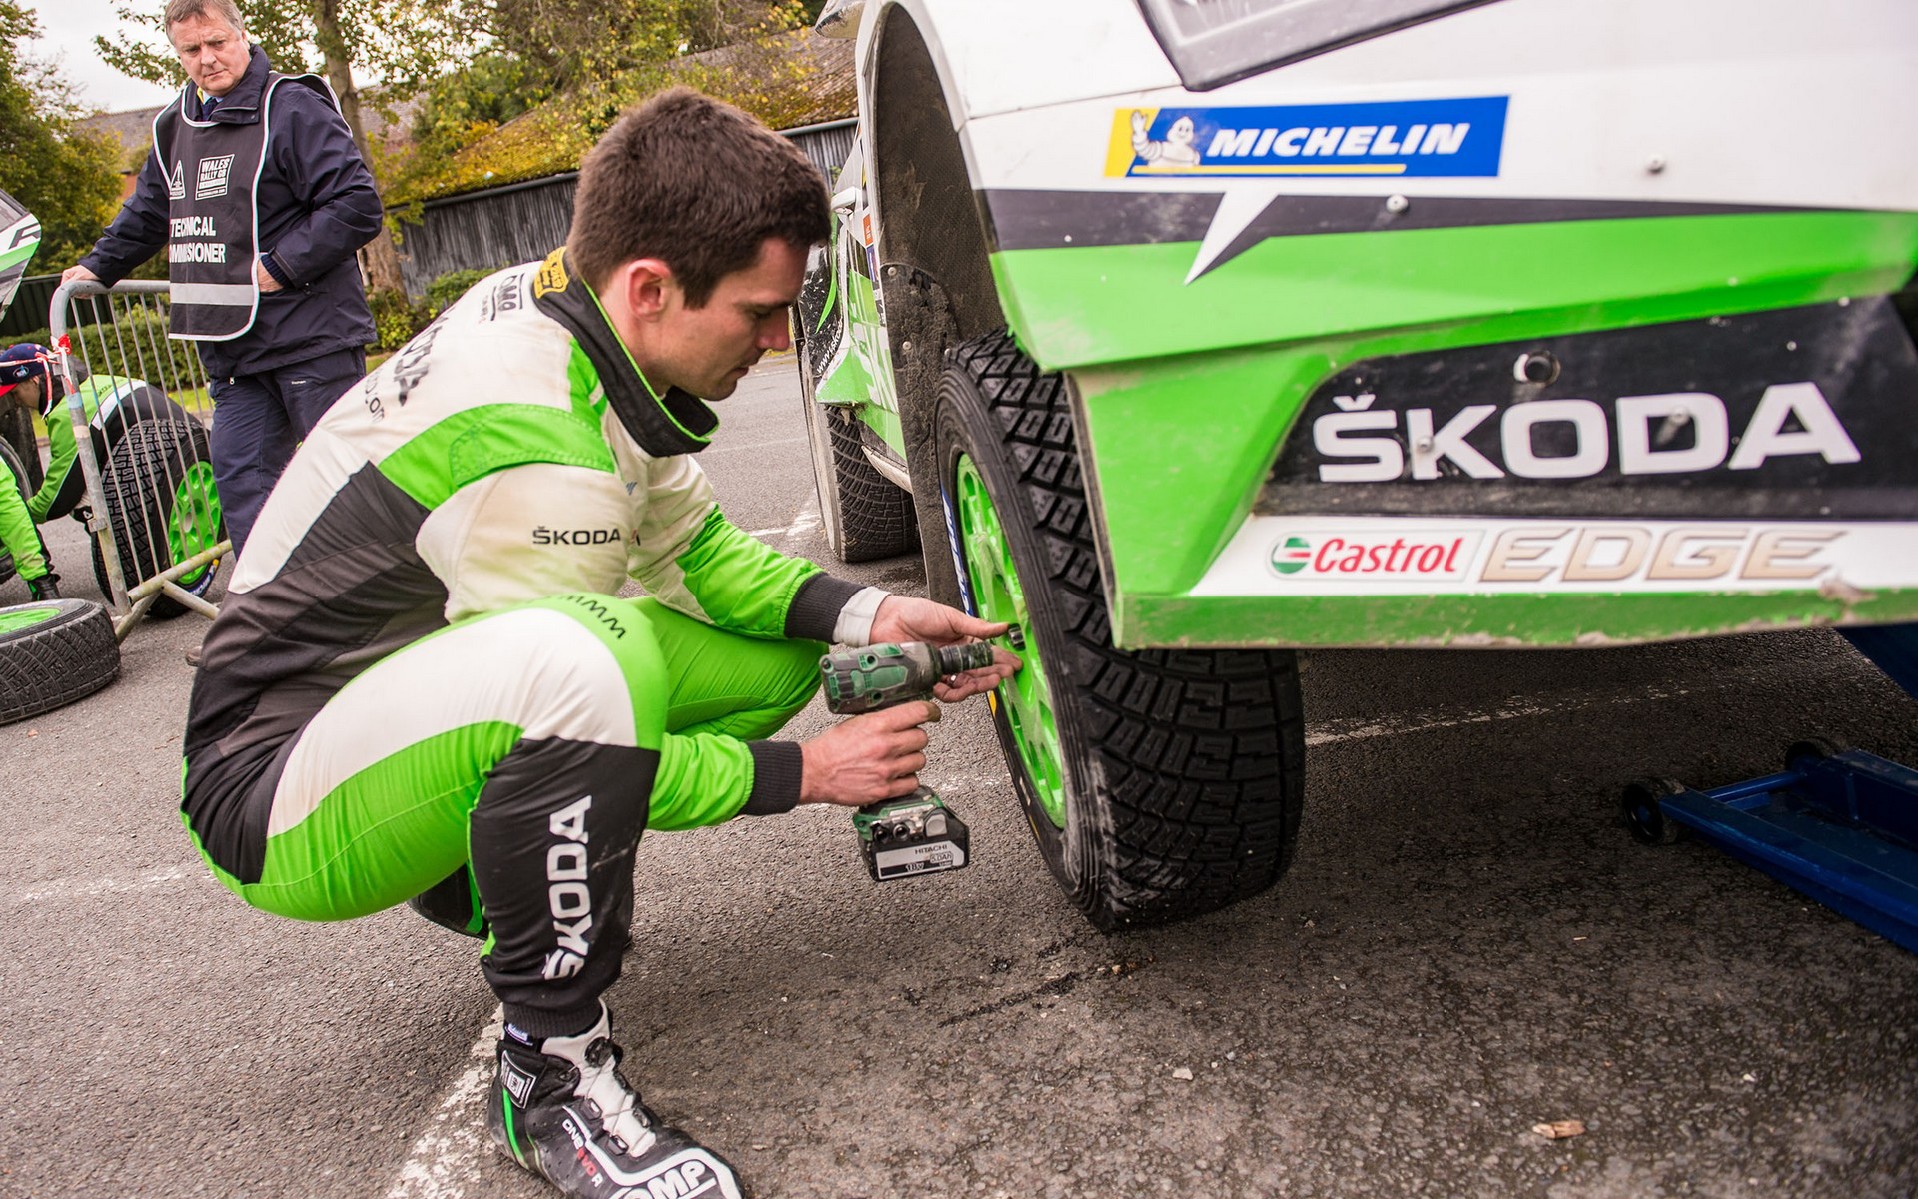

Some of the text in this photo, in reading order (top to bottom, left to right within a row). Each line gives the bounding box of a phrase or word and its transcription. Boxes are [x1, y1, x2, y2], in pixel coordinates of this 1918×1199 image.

[1206, 123, 1470, 157] MICHELIN
[201, 158, 230, 173] WALES
[1313, 382, 1861, 483] ŠKODA
[532, 526, 621, 545] ŠKODA
[1313, 526, 1849, 583] Castrol EDGE
[914, 844, 948, 855] HITACHI
[541, 795, 593, 981] ŠKODA
